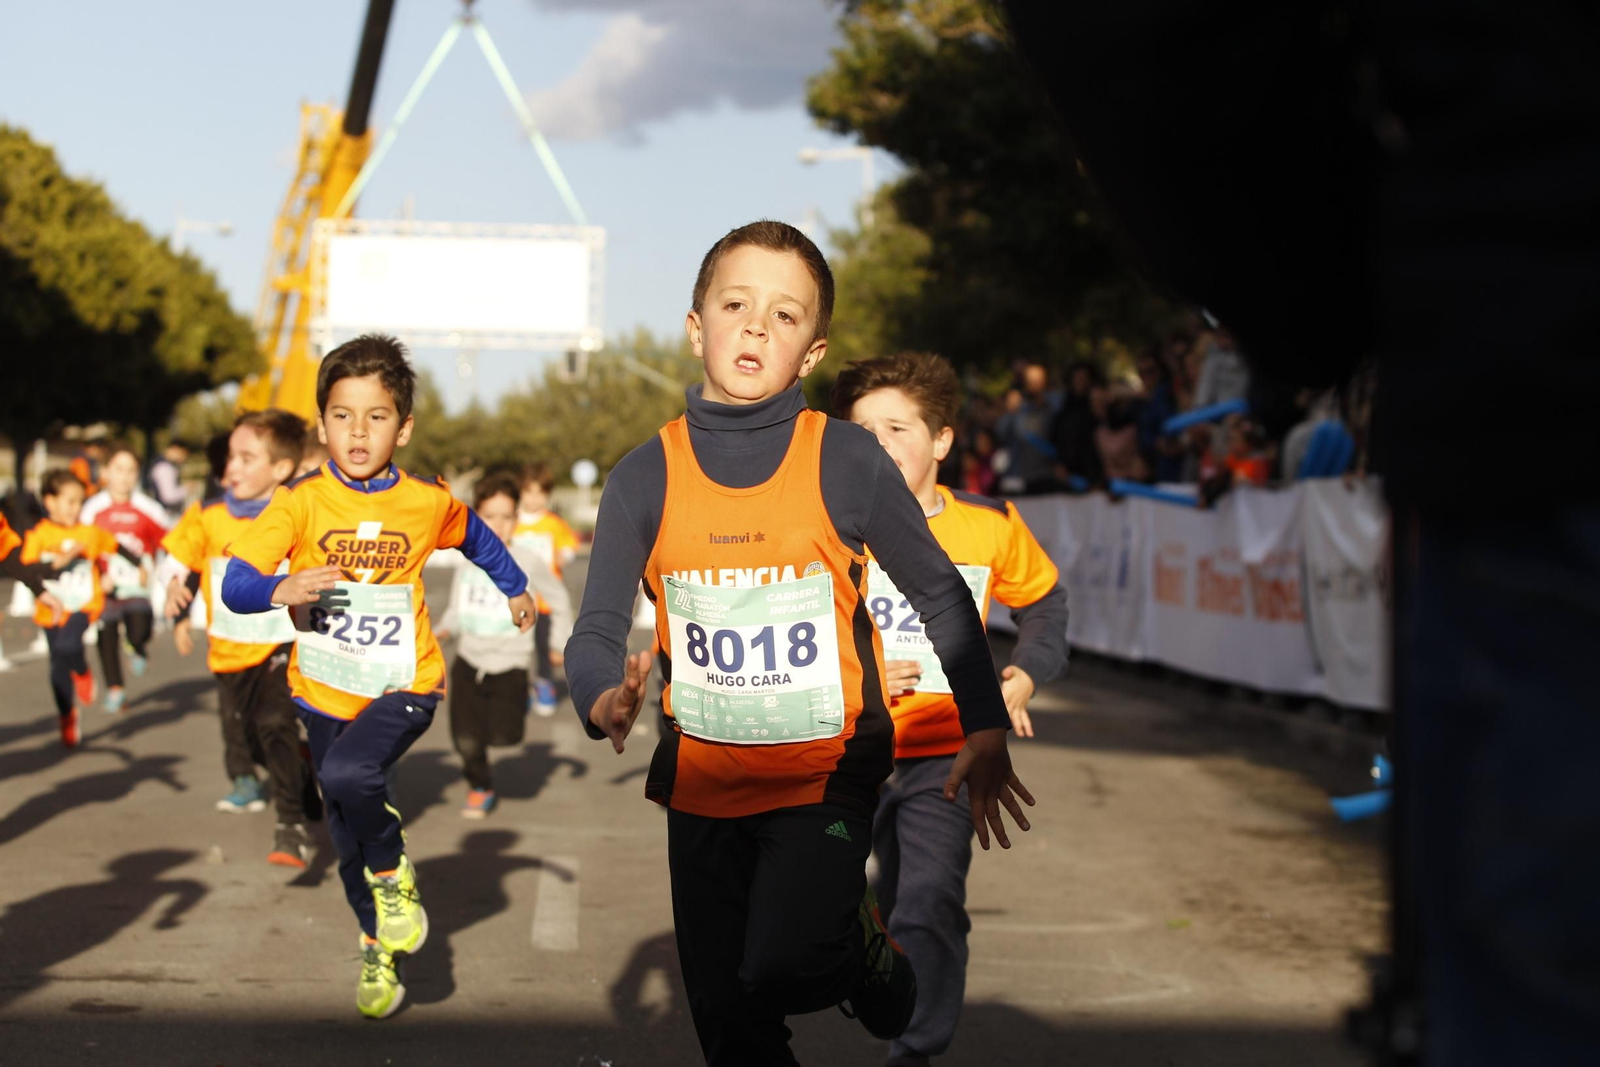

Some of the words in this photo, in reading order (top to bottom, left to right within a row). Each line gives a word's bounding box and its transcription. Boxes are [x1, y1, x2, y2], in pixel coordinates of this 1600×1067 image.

[709, 532, 750, 545] luanvi
[335, 539, 400, 554] SUPER
[326, 553, 407, 569] RUNNER
[693, 594, 717, 604] MEDIO
[766, 586, 821, 602] CARRERA
[694, 602, 731, 613] MARATÓN
[695, 609, 727, 620] ALMERÍA
[769, 599, 822, 615] INFANTIL
[309, 606, 403, 646] 8252
[338, 642, 366, 656] DARIO
[685, 621, 819, 674] 8018
[706, 672, 746, 687] HUGO
[751, 672, 792, 687] CARA
[826, 828, 852, 842] adidas
